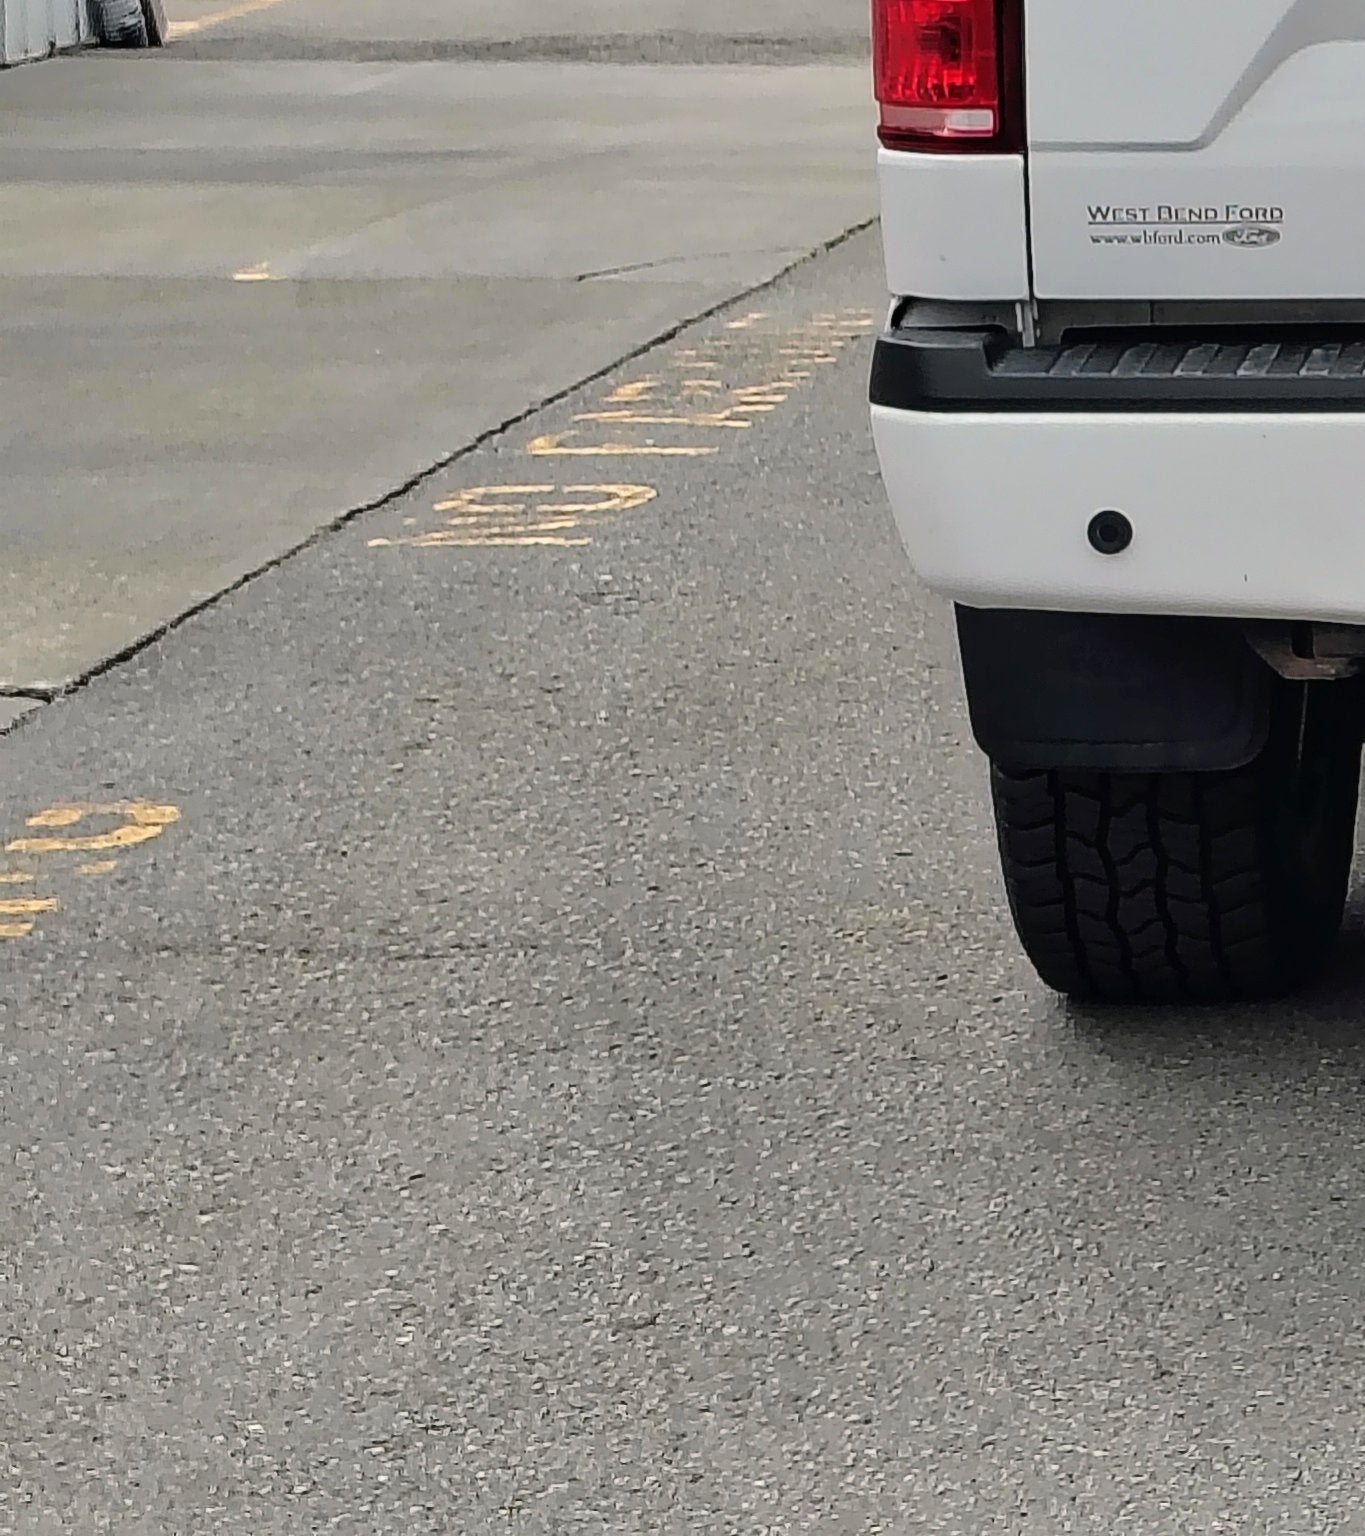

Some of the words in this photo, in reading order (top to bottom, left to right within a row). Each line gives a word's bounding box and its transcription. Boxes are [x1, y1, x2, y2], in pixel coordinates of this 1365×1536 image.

[1087, 205, 1149, 222] WEST
[1157, 205, 1218, 222] BEND
[1225, 204, 1284, 222] FORD
[1089, 229, 1221, 245] www.wbford.com
